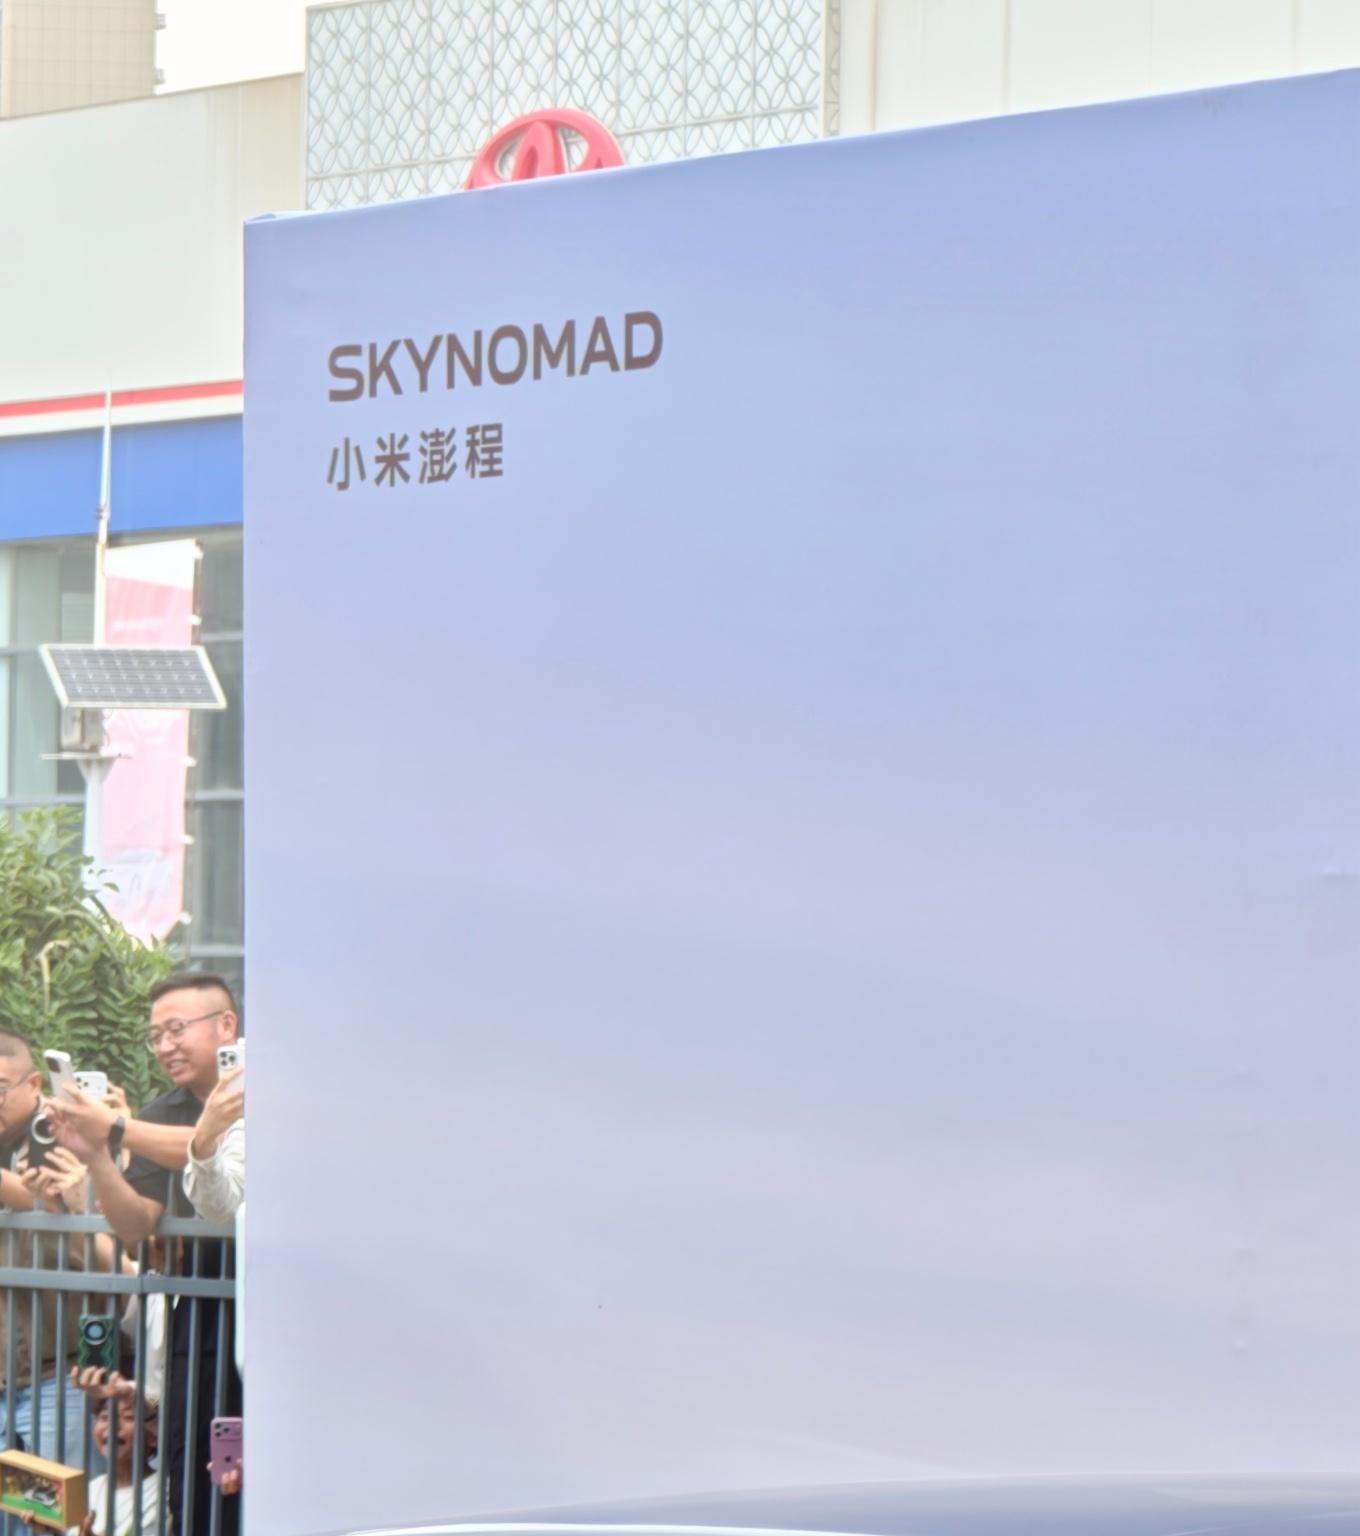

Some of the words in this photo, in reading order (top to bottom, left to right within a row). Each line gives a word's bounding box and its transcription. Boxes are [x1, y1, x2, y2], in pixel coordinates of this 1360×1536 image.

[328, 311, 664, 402] SKYNOMAD
[327, 422, 503, 491] 小米澎程
